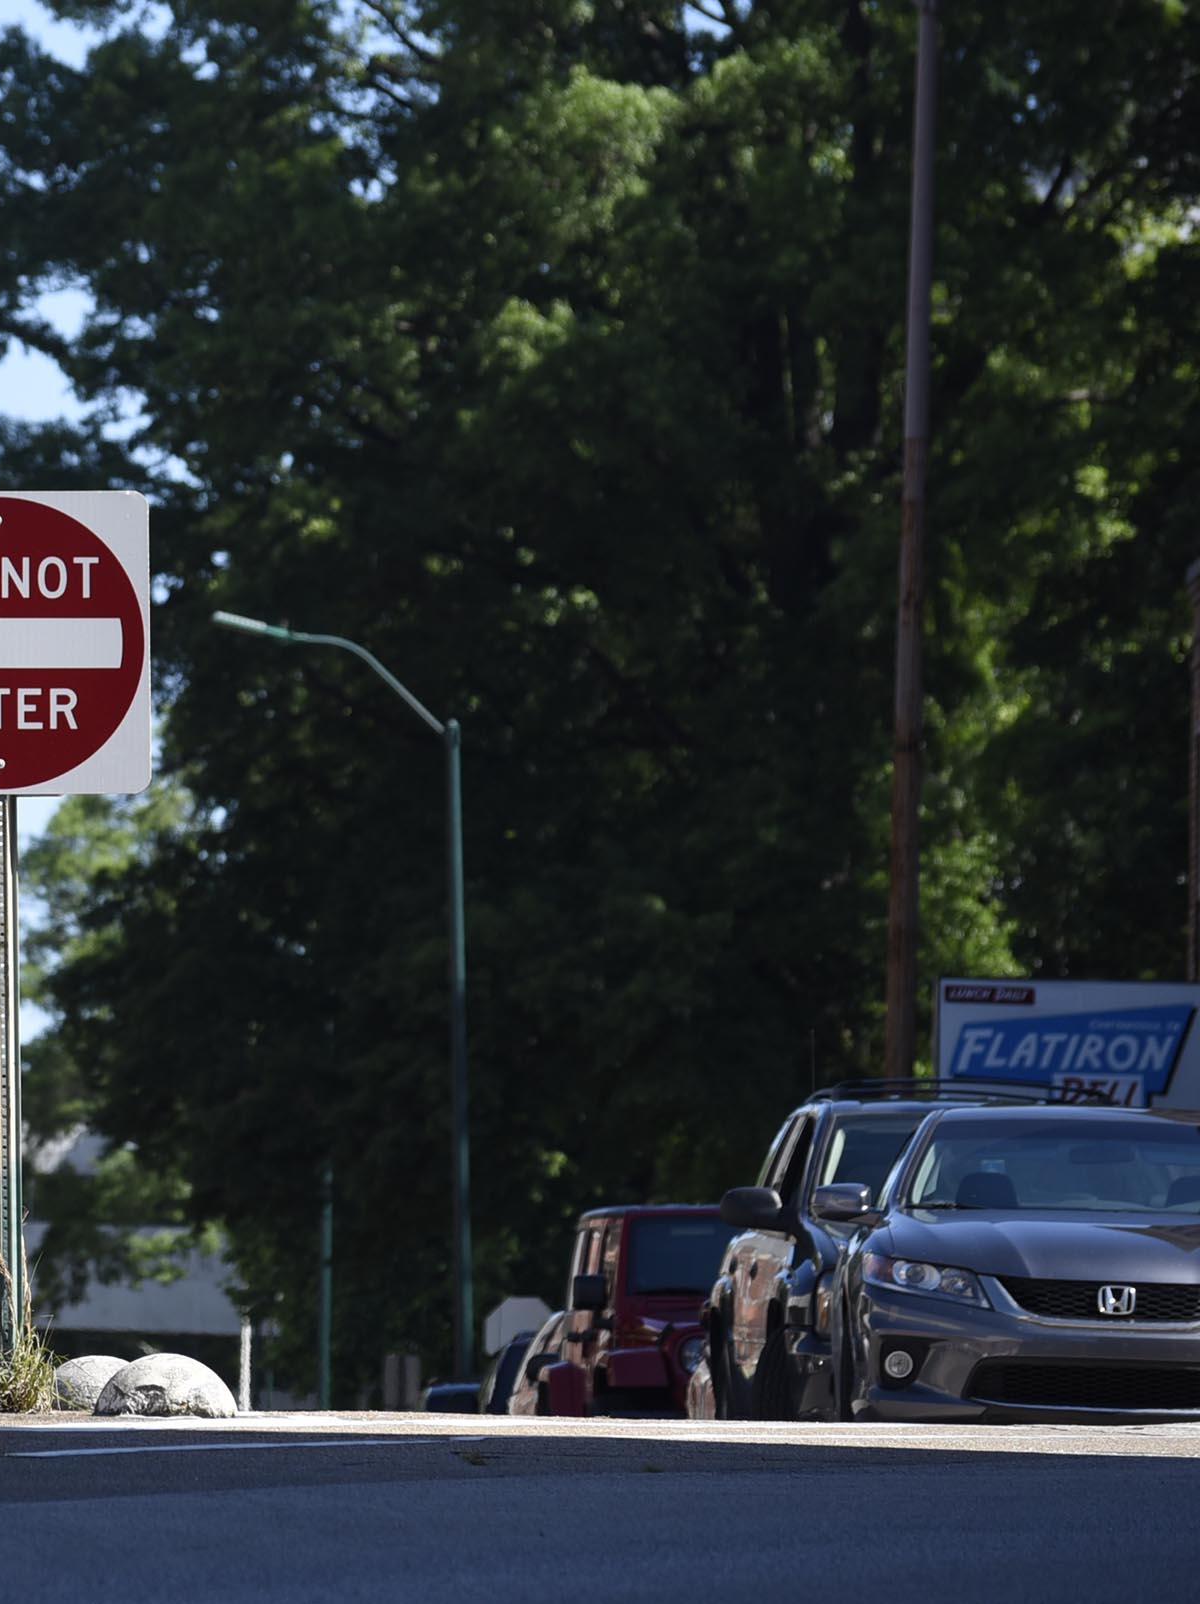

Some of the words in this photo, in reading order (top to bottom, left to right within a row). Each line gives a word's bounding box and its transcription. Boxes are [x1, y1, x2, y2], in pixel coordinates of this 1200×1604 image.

[0, 556, 99, 599] NOT
[950, 987, 992, 1000] LUNCH
[957, 1028, 1174, 1072] FLATIRON
